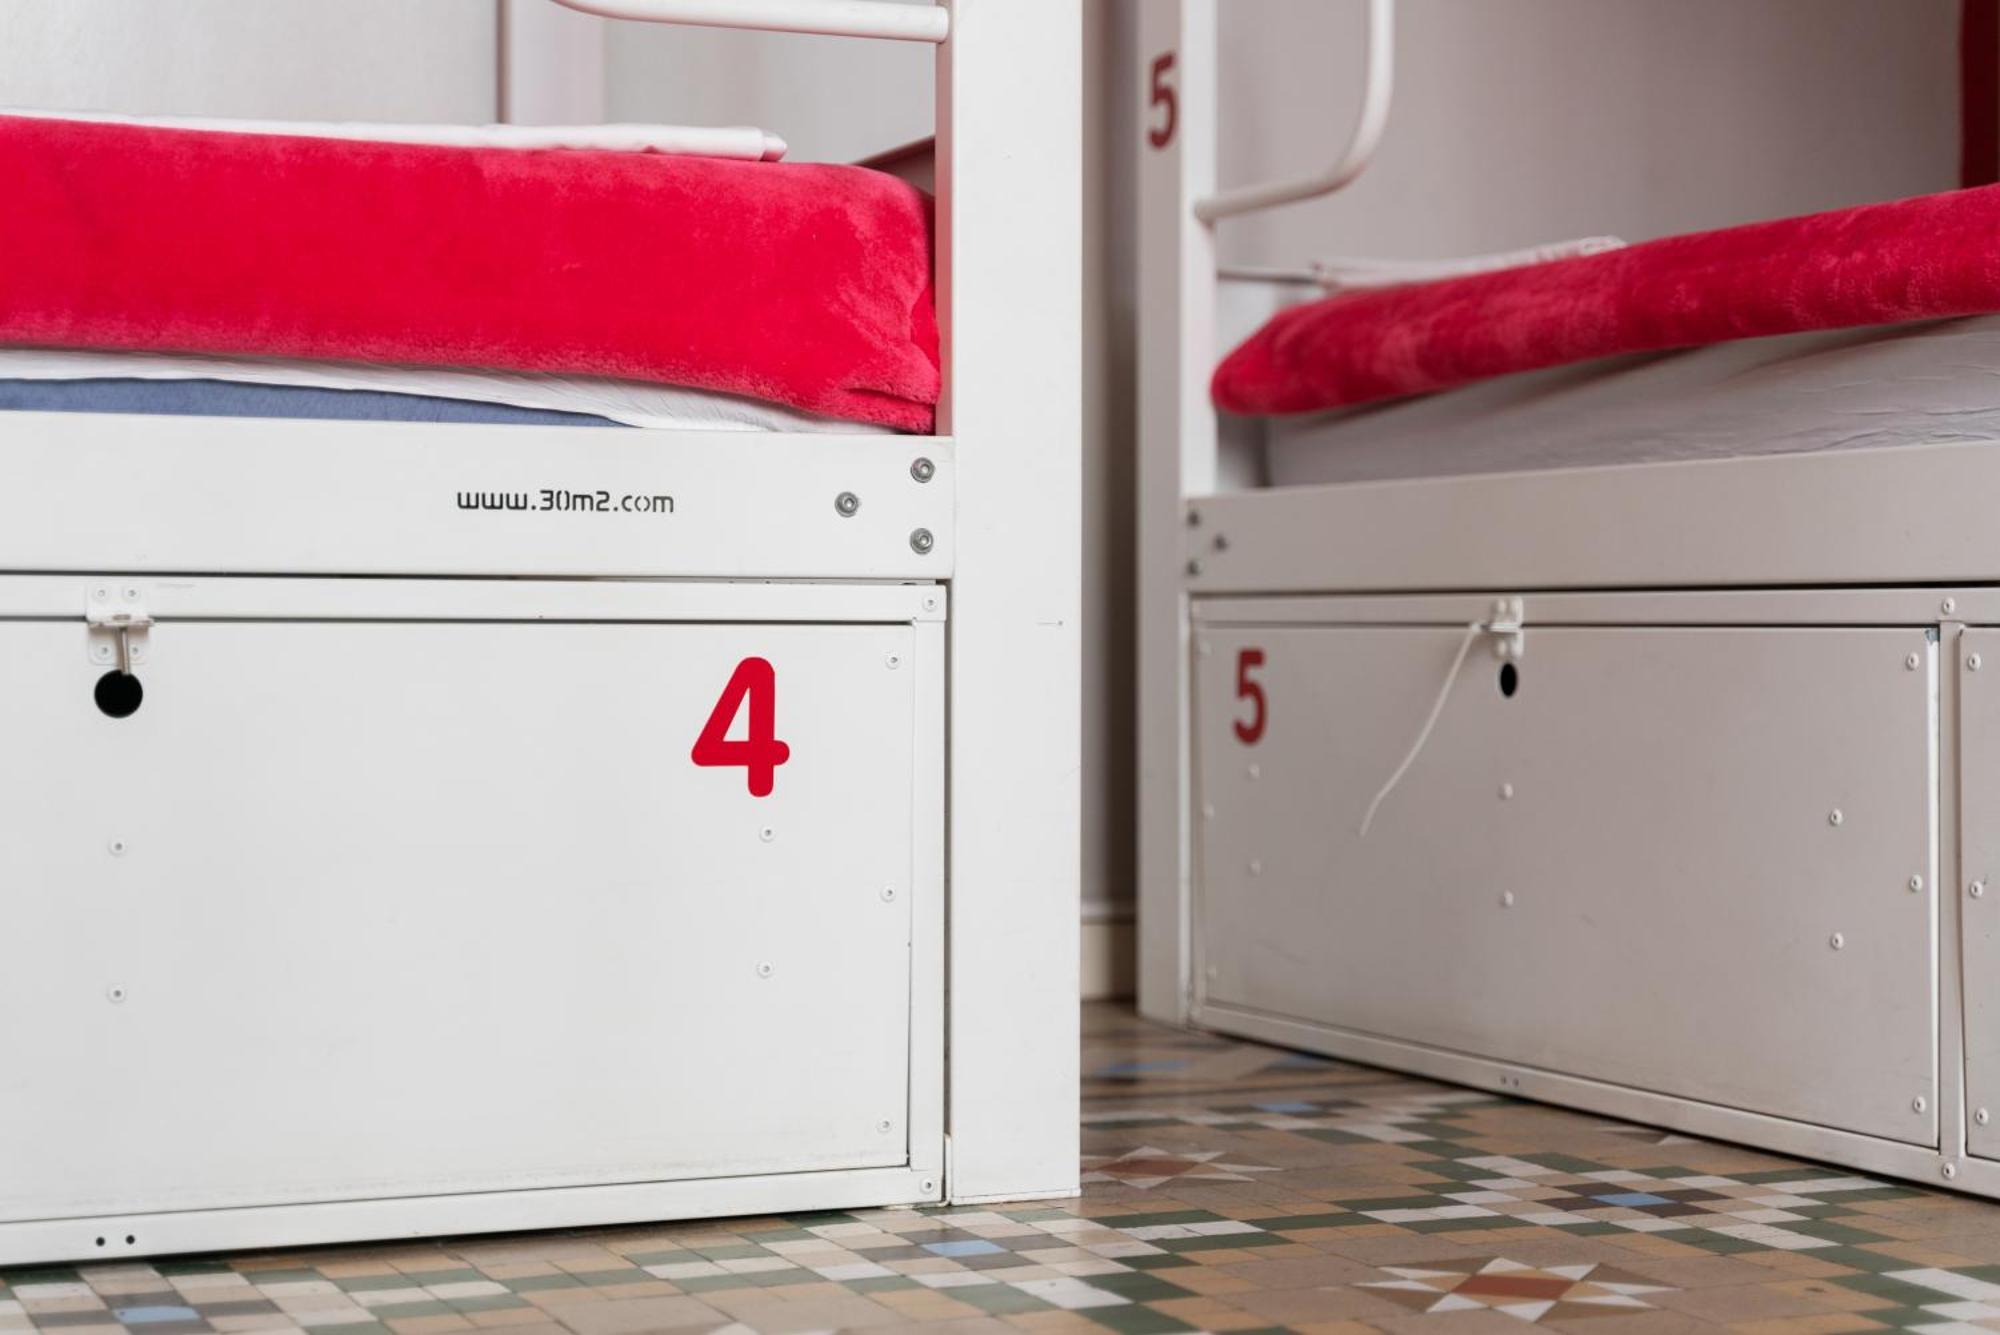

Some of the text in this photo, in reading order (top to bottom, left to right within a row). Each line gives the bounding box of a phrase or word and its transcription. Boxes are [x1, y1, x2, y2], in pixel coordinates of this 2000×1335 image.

[1149, 52, 1177, 148] 5
[457, 489, 674, 513] www.30m2.com
[690, 656, 791, 798] 4
[1233, 648, 1266, 744] 5
